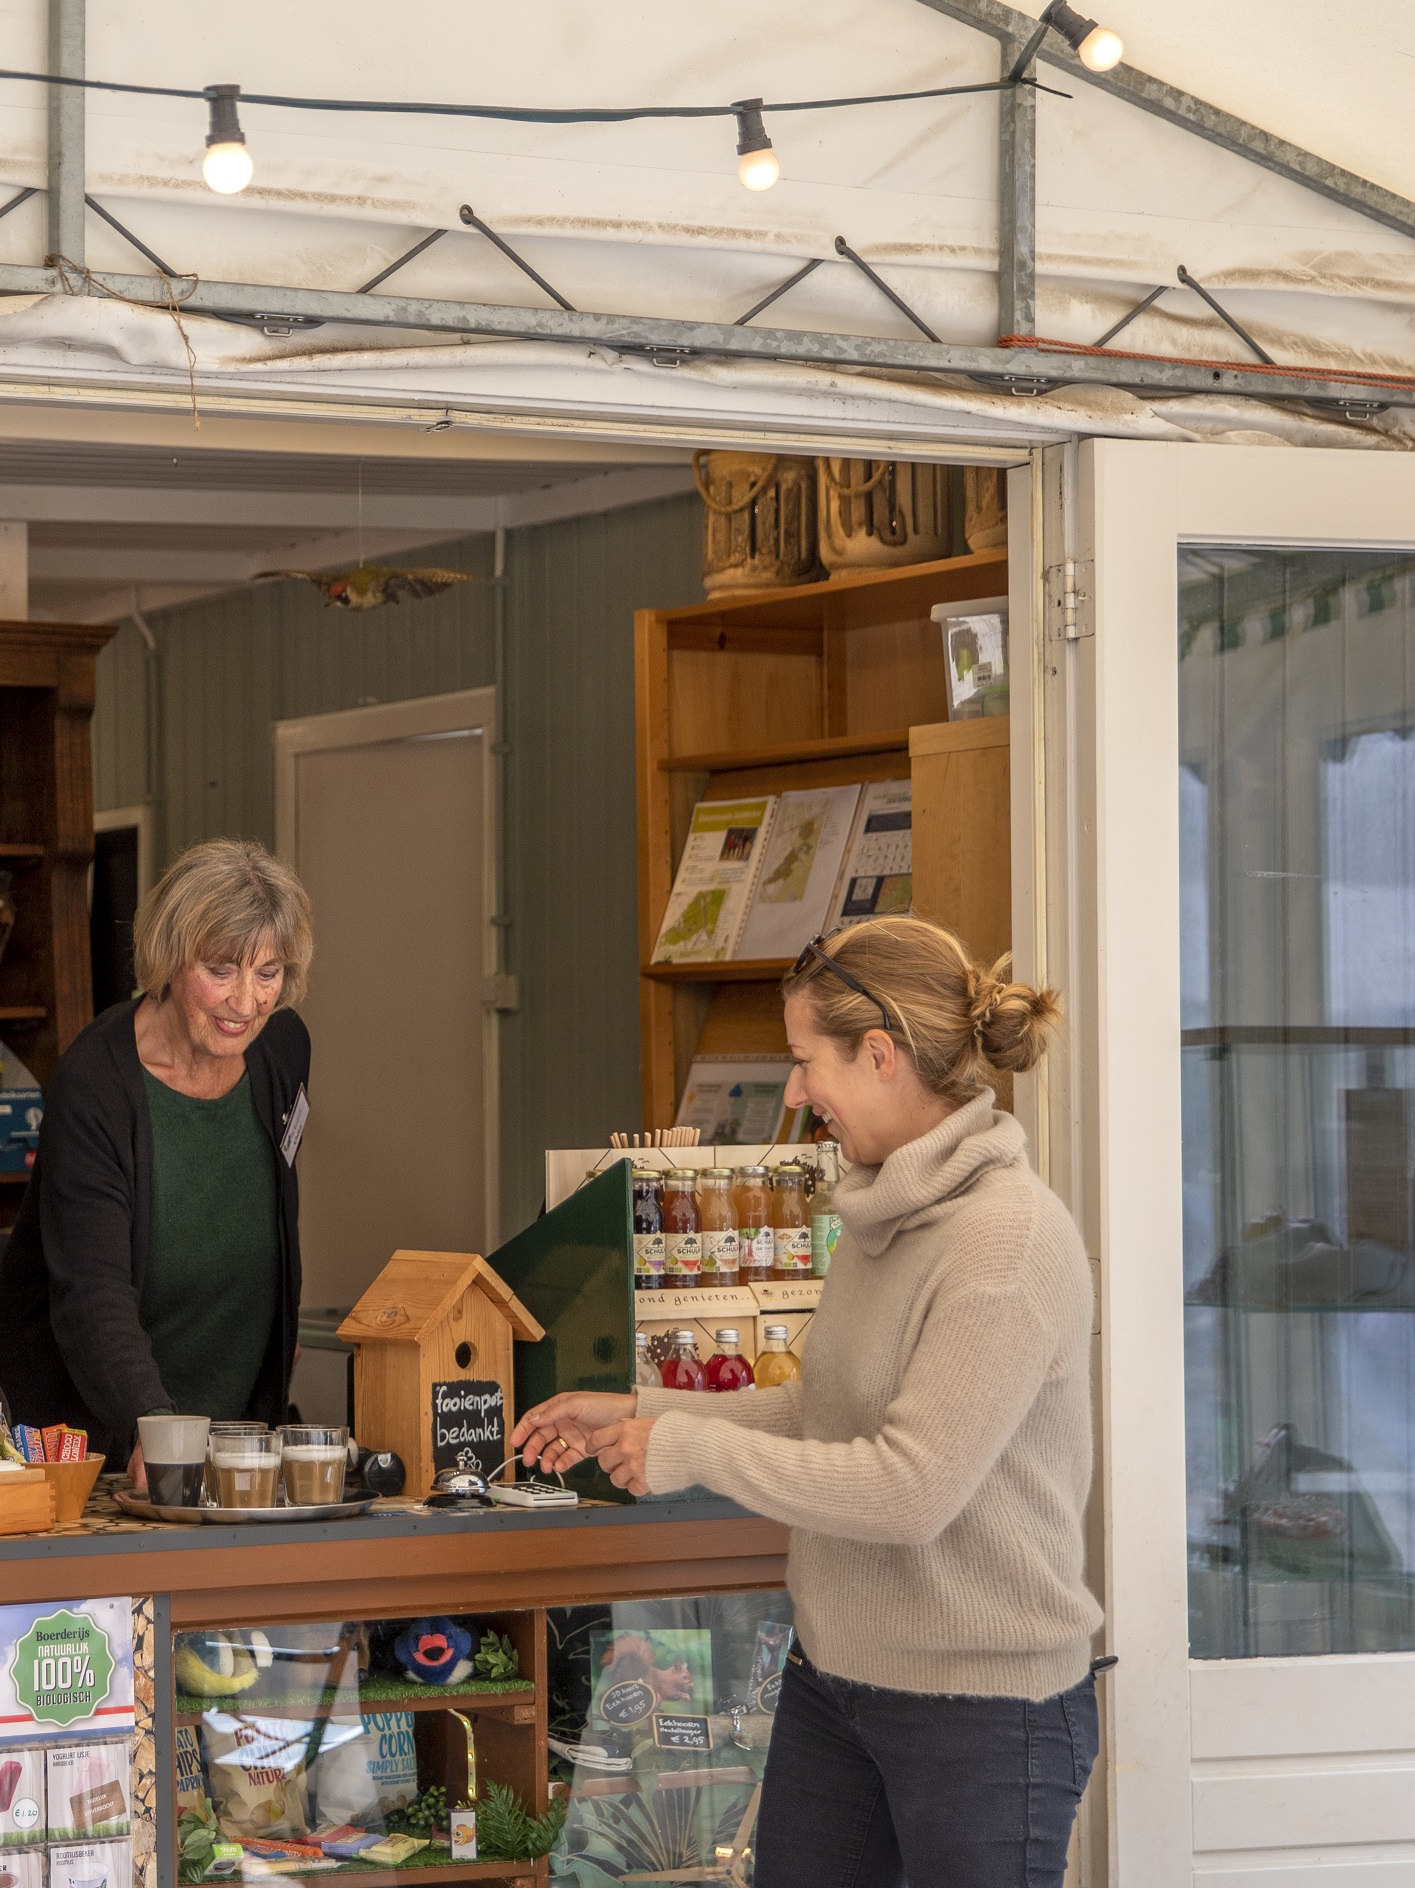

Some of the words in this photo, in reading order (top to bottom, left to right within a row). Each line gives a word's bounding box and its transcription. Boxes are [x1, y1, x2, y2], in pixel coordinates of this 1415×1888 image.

[436, 1385, 503, 1418] fooienpot
[436, 1416, 502, 1448] bedankt
[62, 1434, 73, 1460] CHOCO
[36, 1627, 90, 1642] Boerderijs
[38, 1642, 89, 1658] NATUURLIJK
[34, 1655, 96, 1692] 100%
[36, 1691, 92, 1706] BIOLOGISCH
[379, 1730, 415, 1760] CORN
[366, 1758, 399, 1774] SIMPLY
